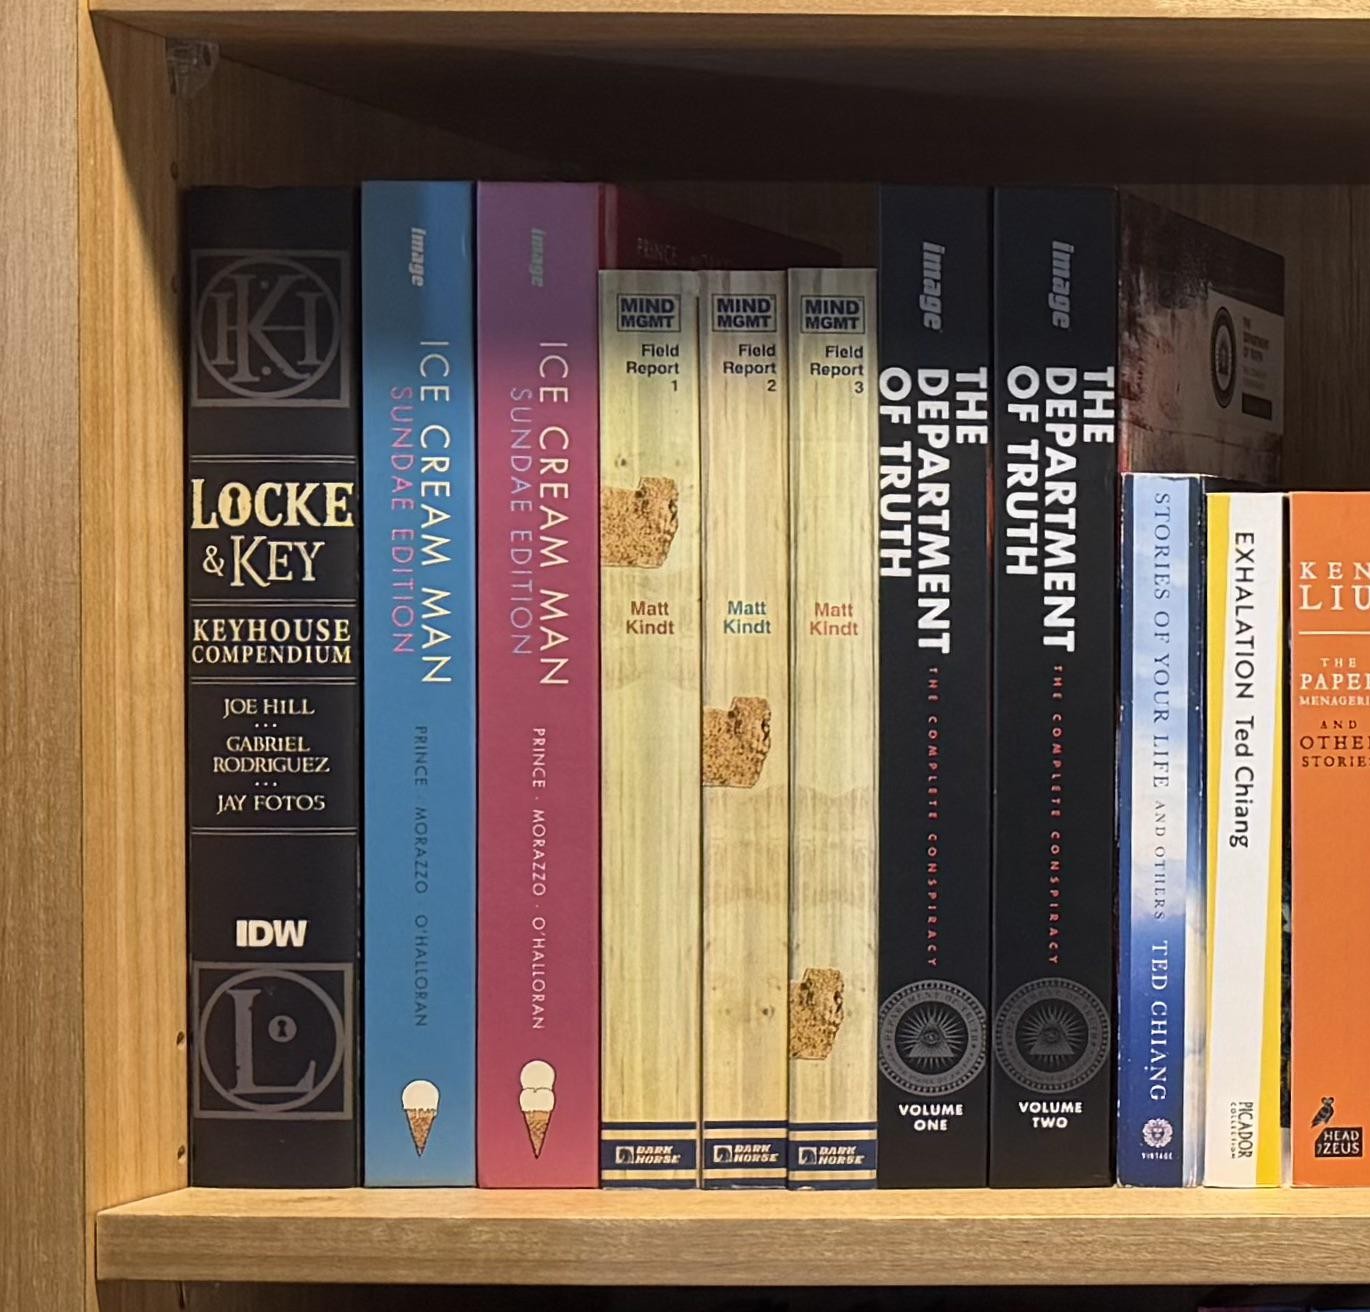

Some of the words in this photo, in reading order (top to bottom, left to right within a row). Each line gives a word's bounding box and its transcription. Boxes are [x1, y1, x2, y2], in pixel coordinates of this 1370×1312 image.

[419, 341, 449, 402] ICE
[1007, 366, 1037, 422] OF
[192, 480, 355, 529] LOCKE
[419, 425, 450, 568] CREAM
[1007, 437, 1037, 576] TRUTH
[1043, 369, 1074, 653] DEPARTMENT
[203, 544, 225, 578] &
[230, 535, 323, 586] KEY
[631, 600, 669, 614] Matt
[1235, 531, 1254, 701] EXHALATION
[192, 618, 351, 642] KEYHOUSE
[422, 584, 451, 684] MAN
[626, 620, 675, 635] Kindt
[192, 644, 352, 664] COMPENDIUM
[223, 698, 256, 715] JOE
[263, 698, 315, 715] HILL
[227, 735, 310, 753] GABRIEL
[1235, 715, 1254, 754] Ted
[213, 756, 330, 774] RODRIGUEZ
[1230, 760, 1249, 848] Chiang
[236, 919, 307, 947] IDW
[1019, 1101, 1082, 1114] VOLUME
[1032, 1116, 1068, 1129] TWO
